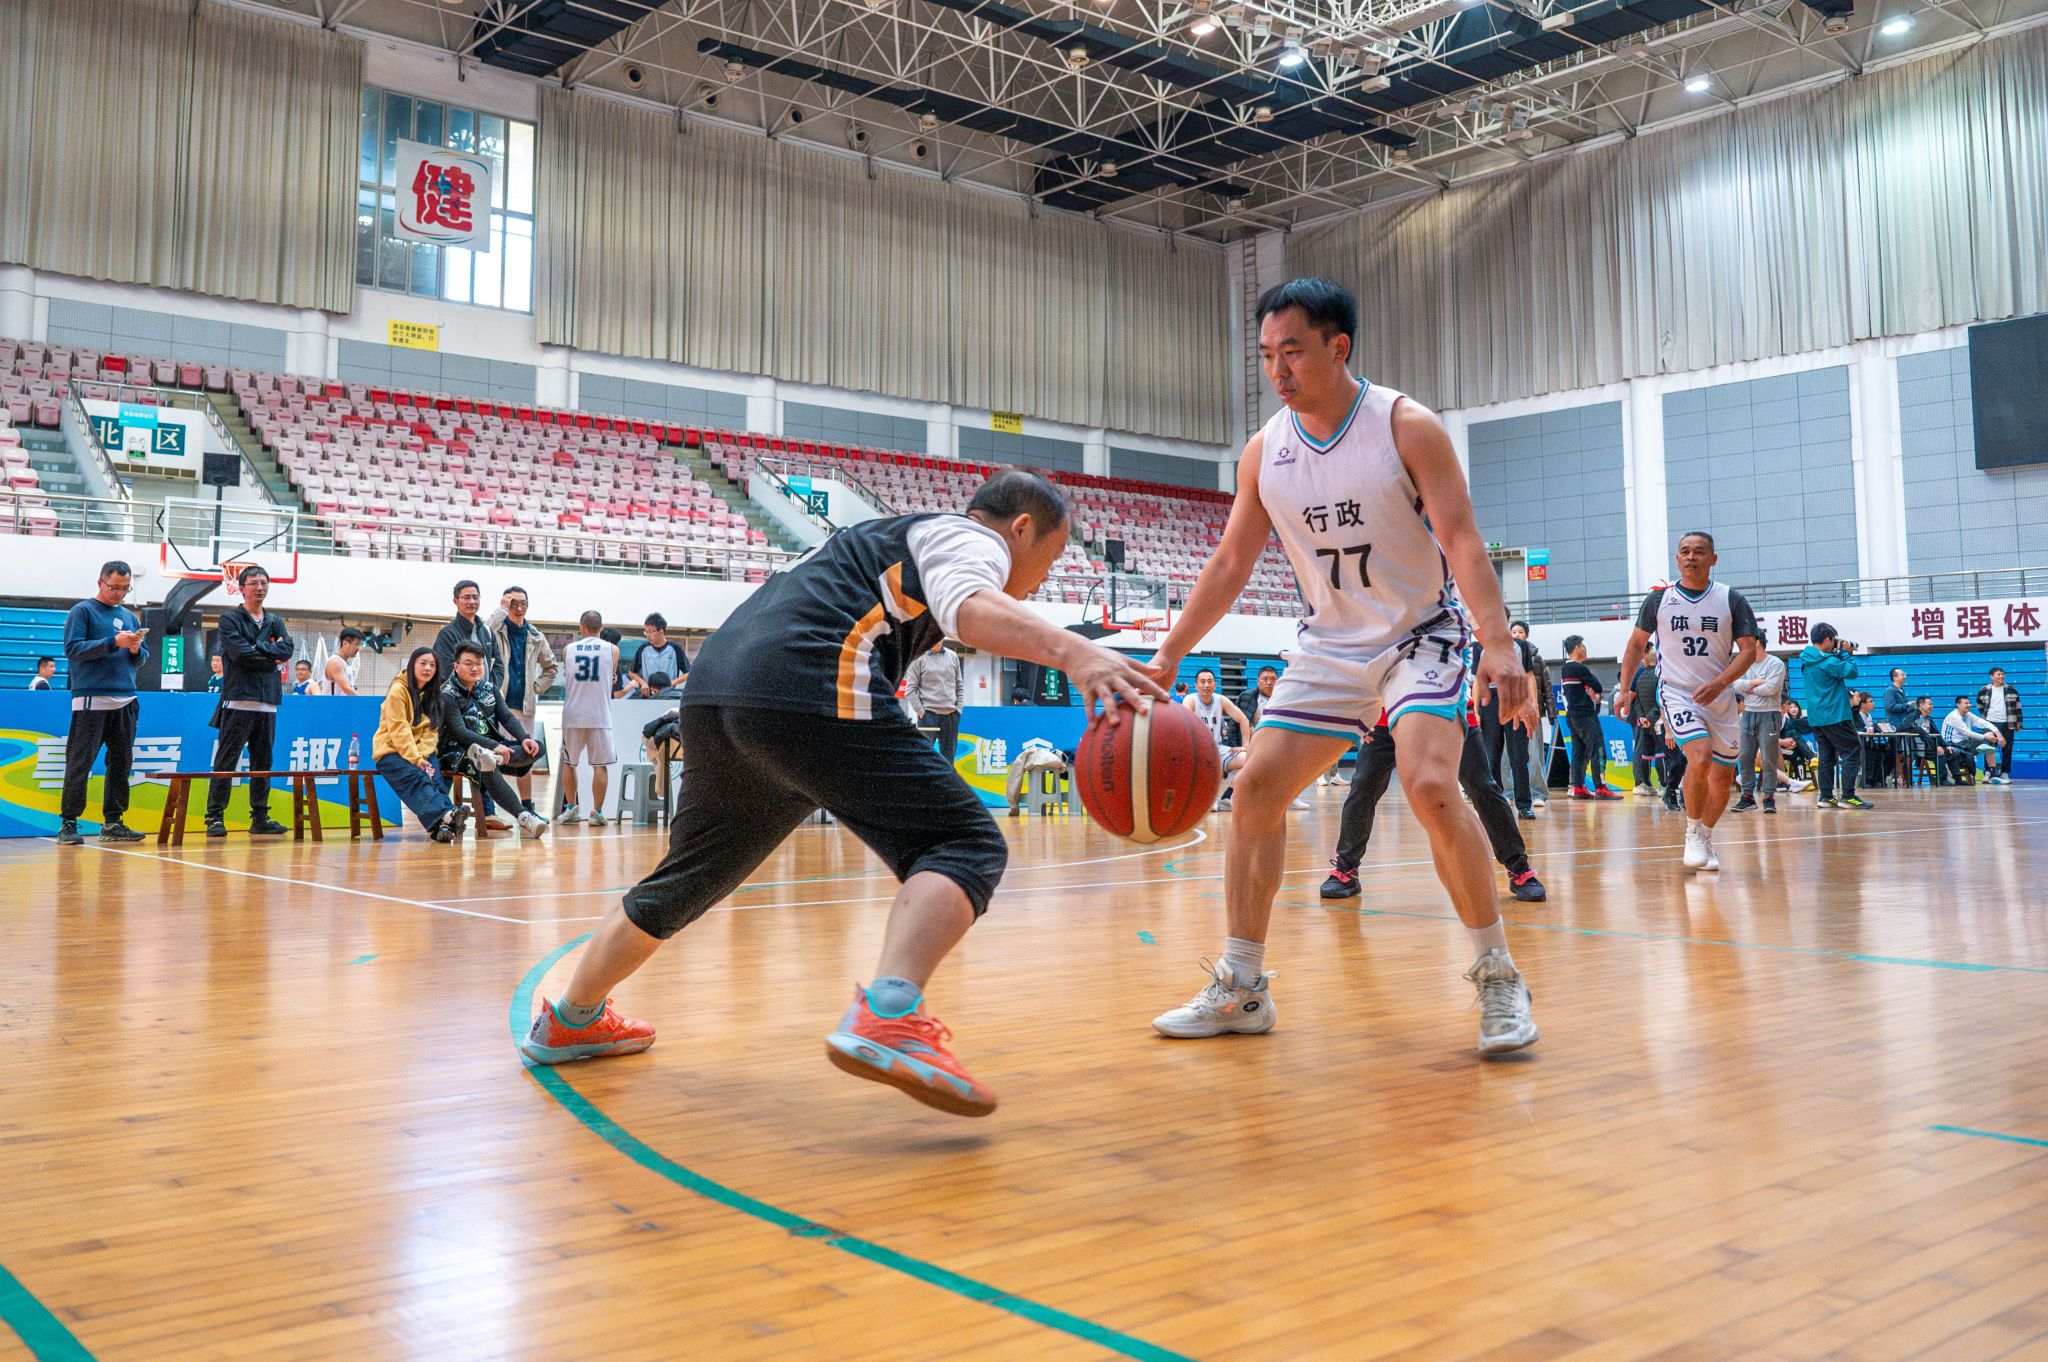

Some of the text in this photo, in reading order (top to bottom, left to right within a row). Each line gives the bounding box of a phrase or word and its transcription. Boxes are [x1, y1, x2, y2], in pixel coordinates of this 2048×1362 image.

[412, 160, 475, 232] 健
[1302, 499, 1365, 533] 行政
[1315, 543, 1372, 590] 77
[1670, 615, 1719, 633] 体育
[1911, 602, 2042, 641] 增强体
[1681, 636, 1709, 657] 32
[575, 655, 600, 682] 31
[1673, 710, 1696, 727] 32
